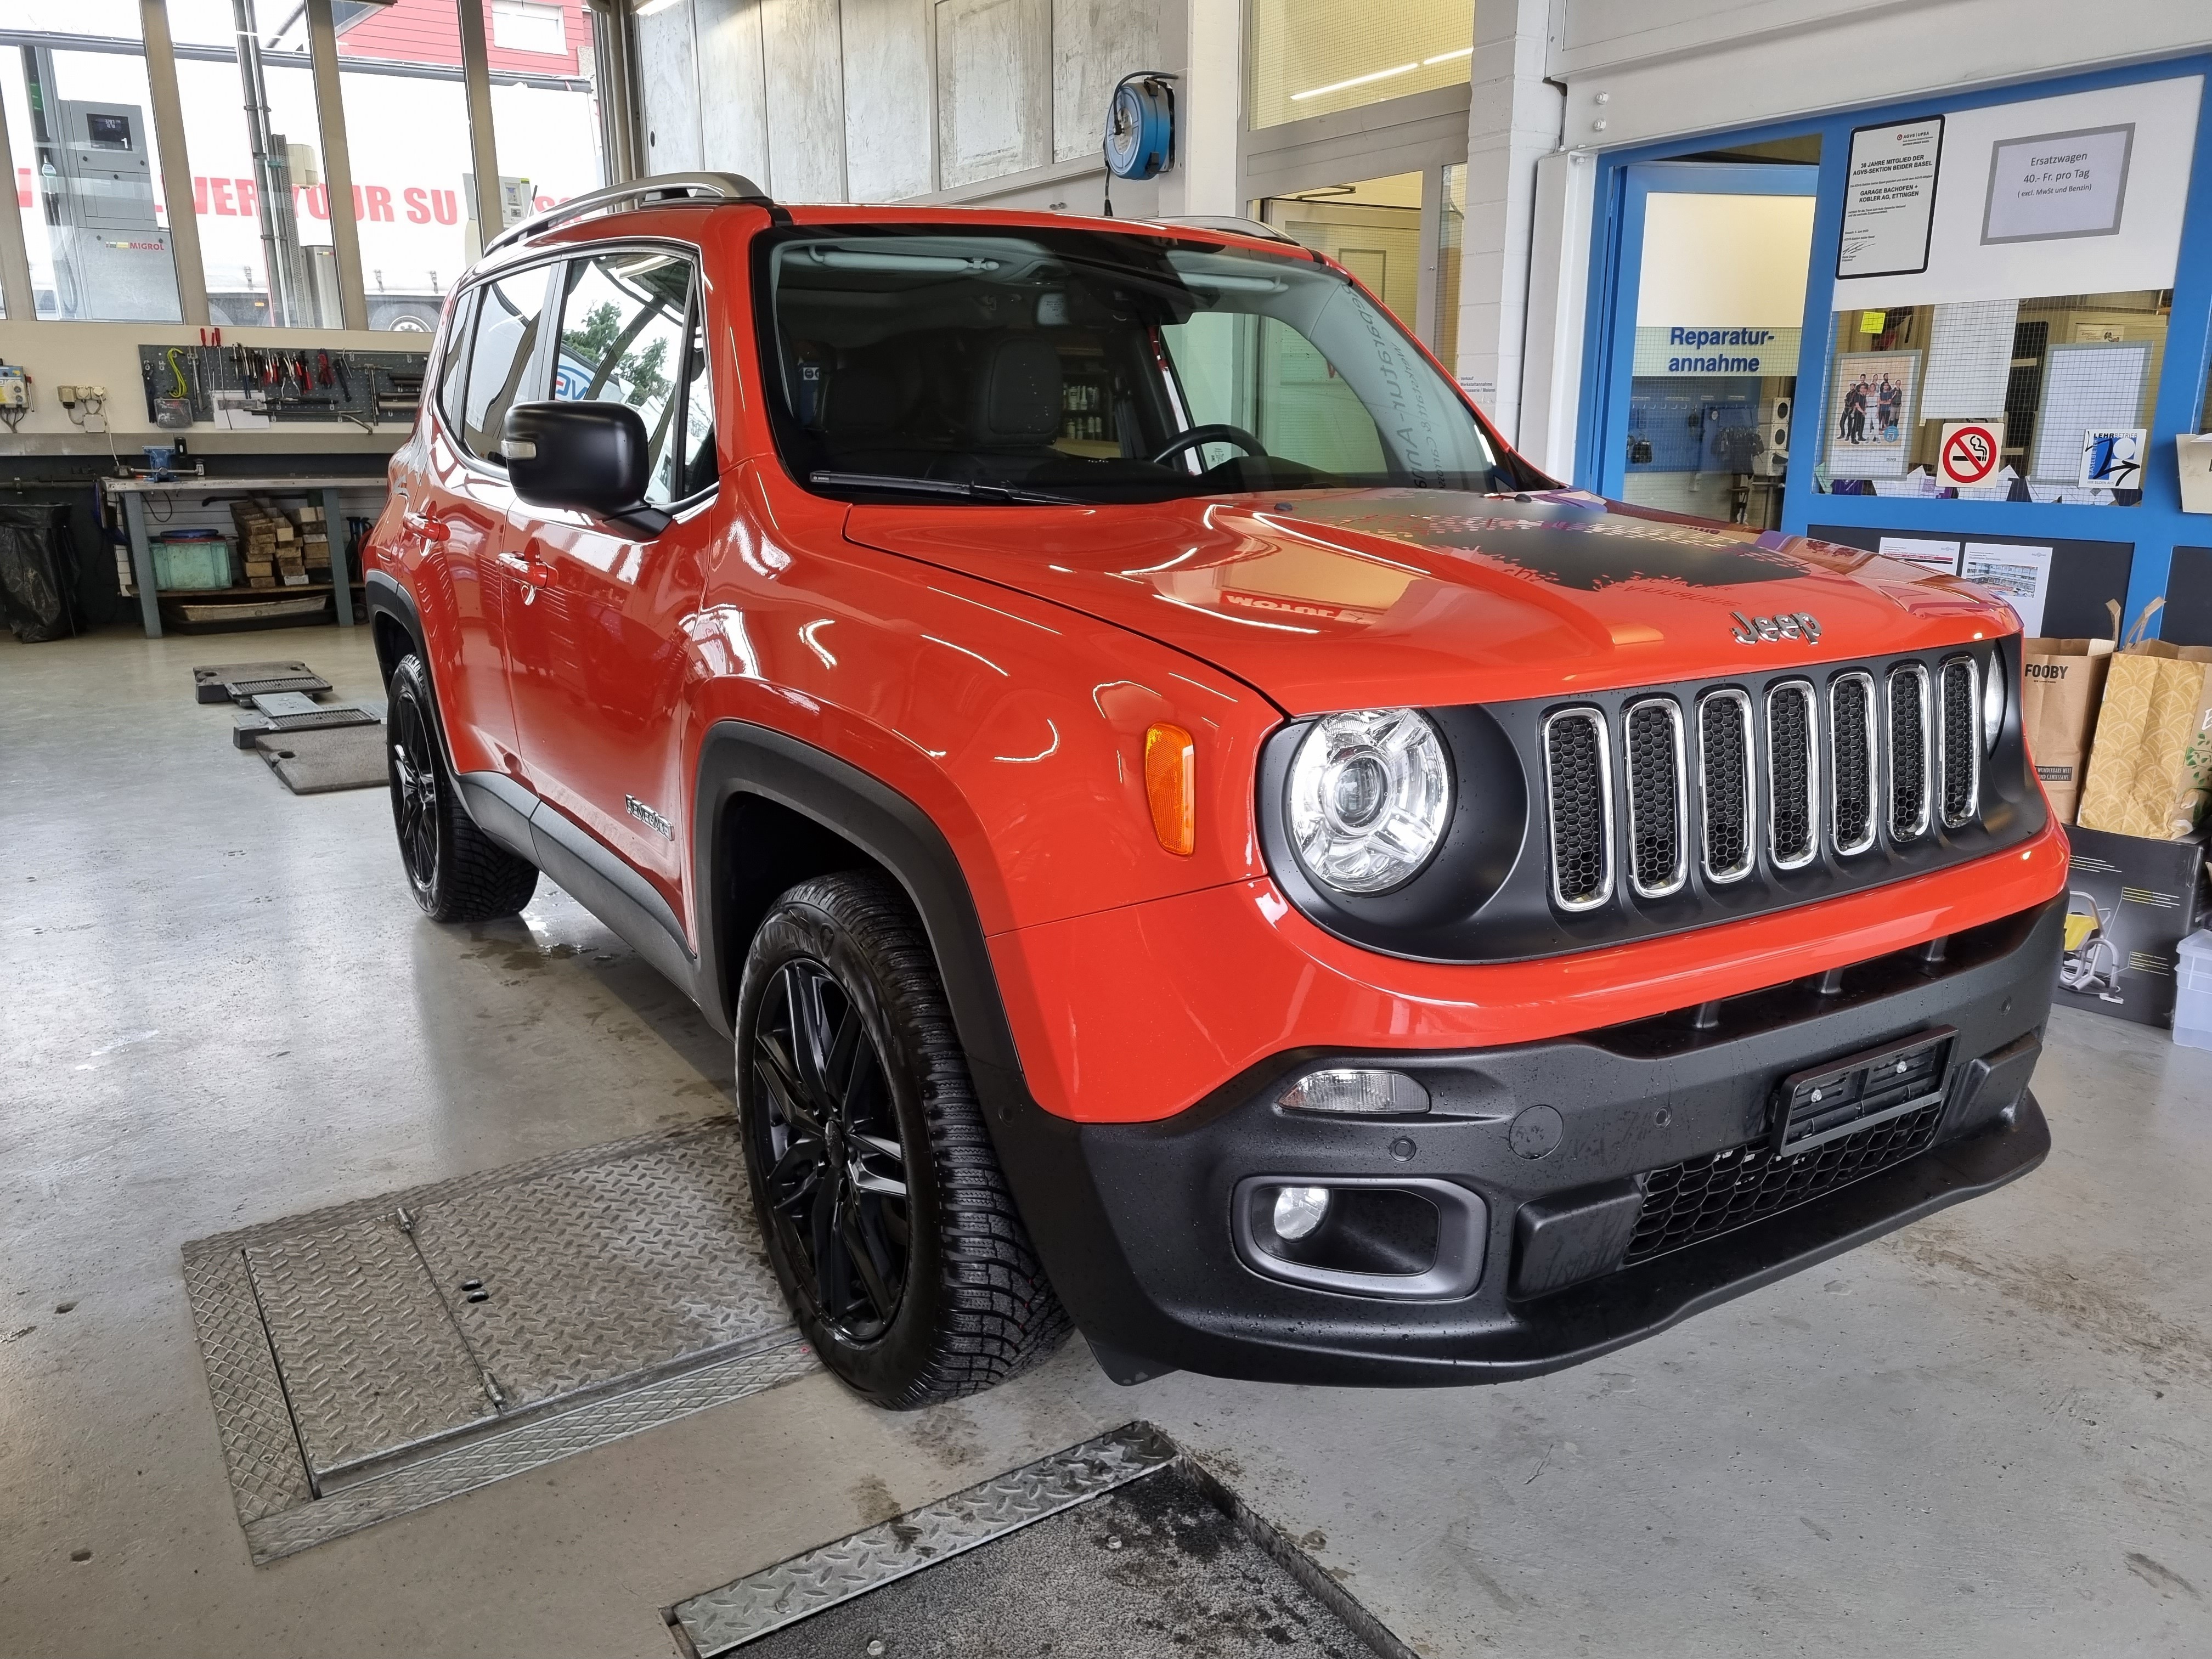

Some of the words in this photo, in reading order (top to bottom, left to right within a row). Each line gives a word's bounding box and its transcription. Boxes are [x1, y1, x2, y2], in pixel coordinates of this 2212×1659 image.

[121, 137, 128, 149] 1
[1887, 156, 1911, 165] MITGLIED
[2031, 153, 2087, 166] Ersatzwagen
[1853, 166, 1892, 176] AGVS-SEKTION
[2023, 174, 2040, 183] 40.-
[2043, 173, 2052, 182] Fr.
[2056, 172, 2071, 182] pro
[2074, 169, 2090, 179] Tag
[2068, 184, 2092, 192] Benzin)
[1859, 195, 1881, 203] KOBLER
[1892, 191, 1919, 199] ETTINGEN
[1671, 327, 1774, 349] Reparatur-
[1668, 354, 1760, 372] annahme
[1729, 611, 1822, 646] Jeep
[2025, 664, 2068, 679] FOOBY
